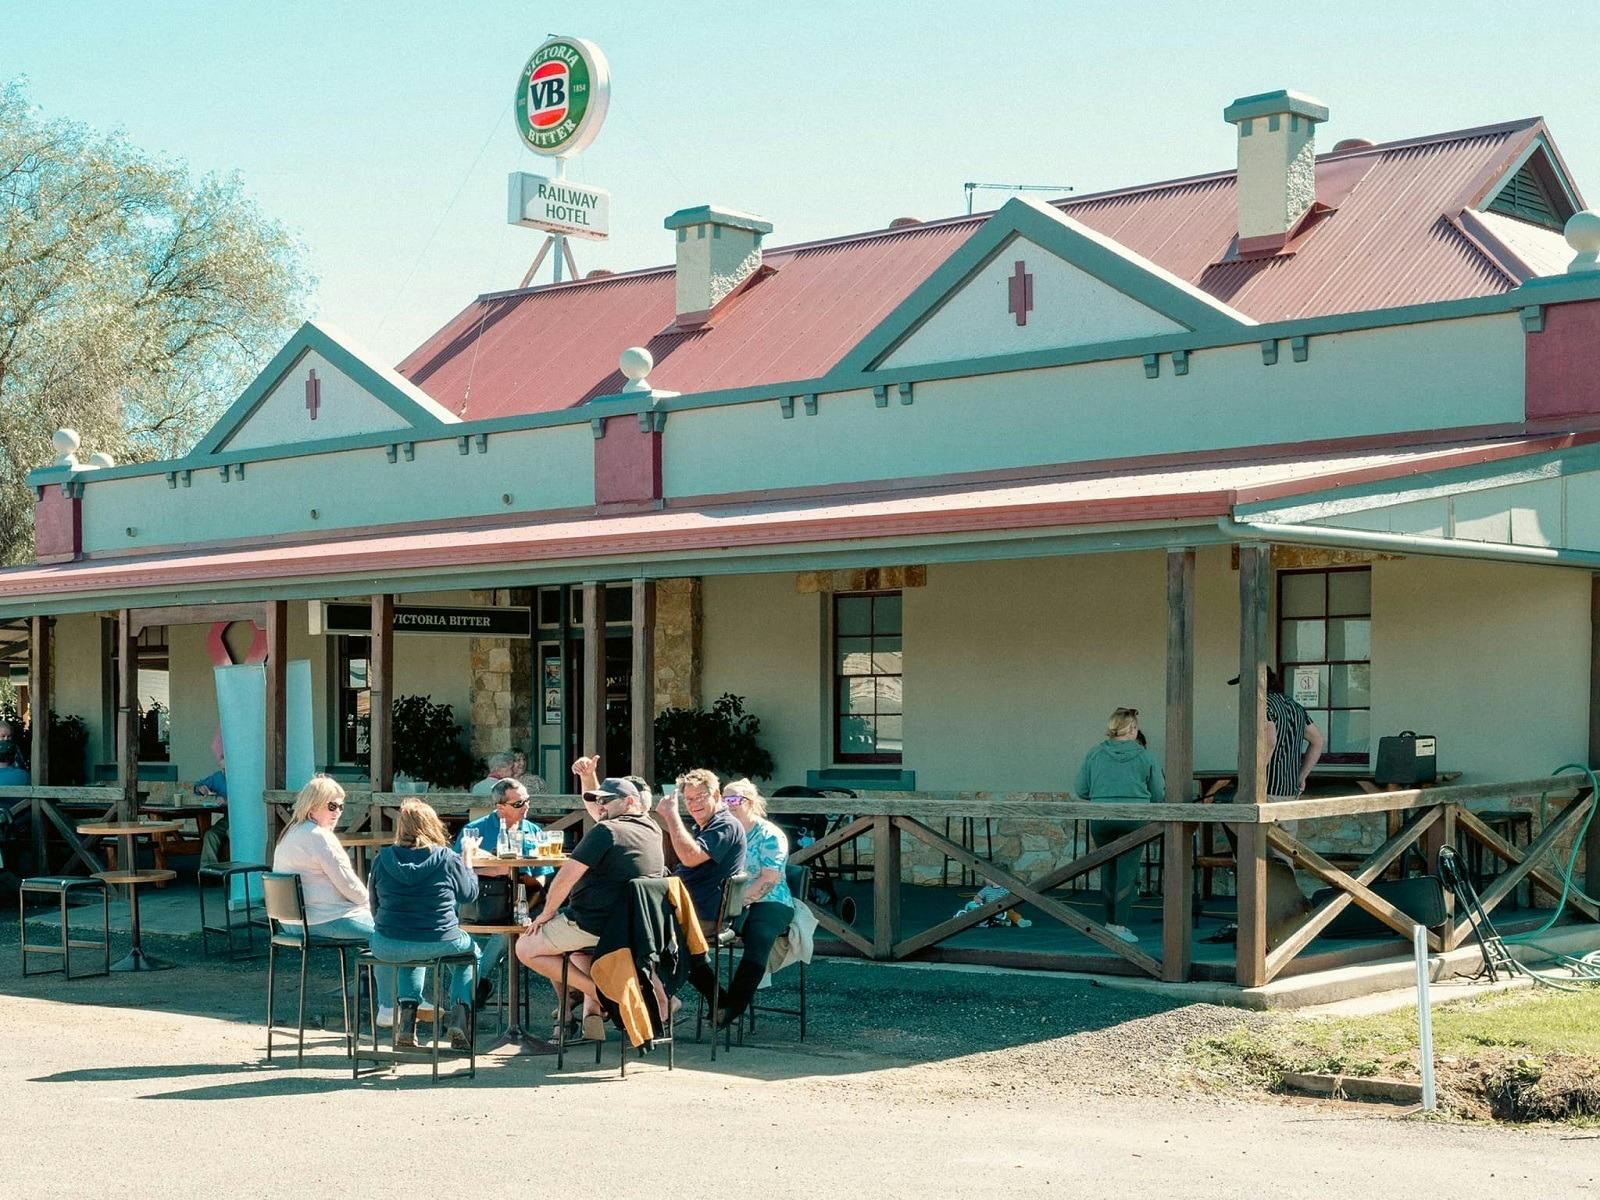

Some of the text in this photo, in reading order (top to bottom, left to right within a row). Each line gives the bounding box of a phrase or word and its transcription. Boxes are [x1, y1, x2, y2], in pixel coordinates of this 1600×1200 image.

[525, 45, 579, 76] VICTORIA
[530, 78, 565, 111] VB
[527, 119, 576, 145] BITTER
[538, 183, 598, 209] RAILWAY
[546, 203, 590, 225] HOTEL
[449, 615, 490, 627] BITTER
